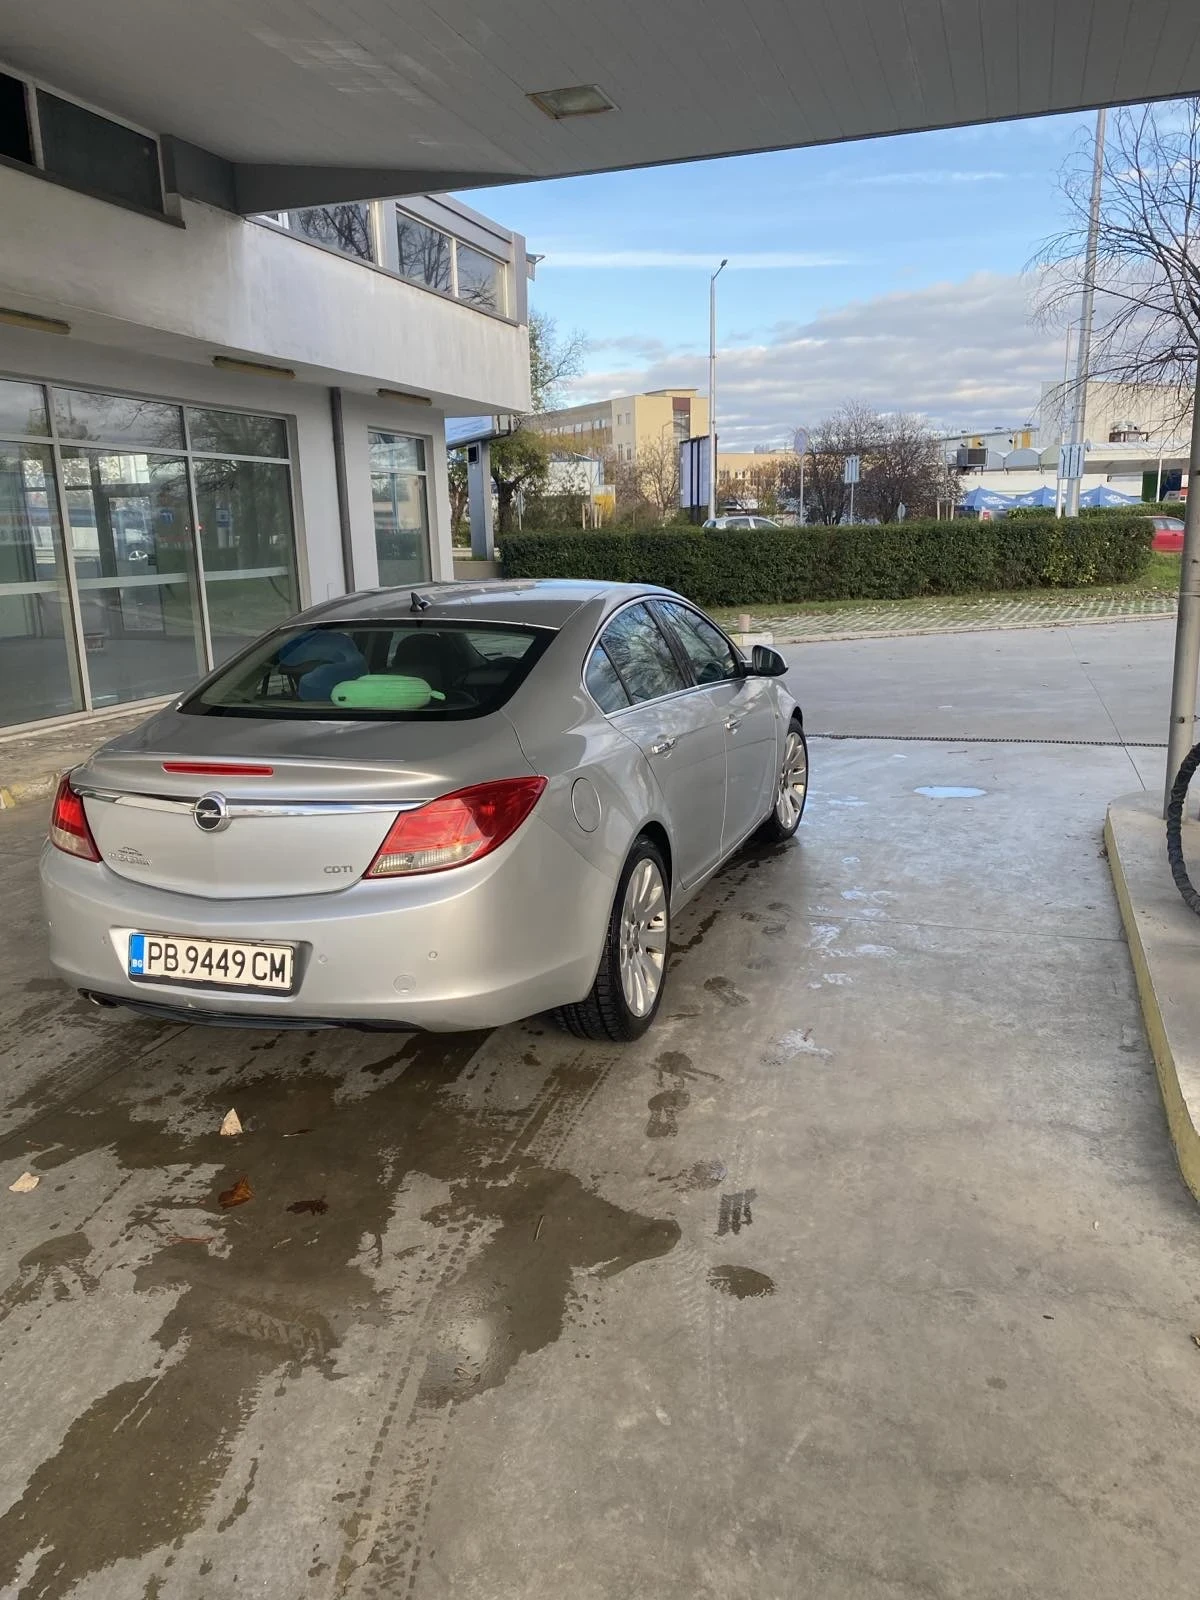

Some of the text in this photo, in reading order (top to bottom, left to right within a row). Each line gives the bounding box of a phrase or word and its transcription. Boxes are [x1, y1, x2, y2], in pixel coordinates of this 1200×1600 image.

[323, 865, 353, 874] CDTI
[132, 959, 143, 968] BG
[148, 942, 286, 983] PB 9449 CM
